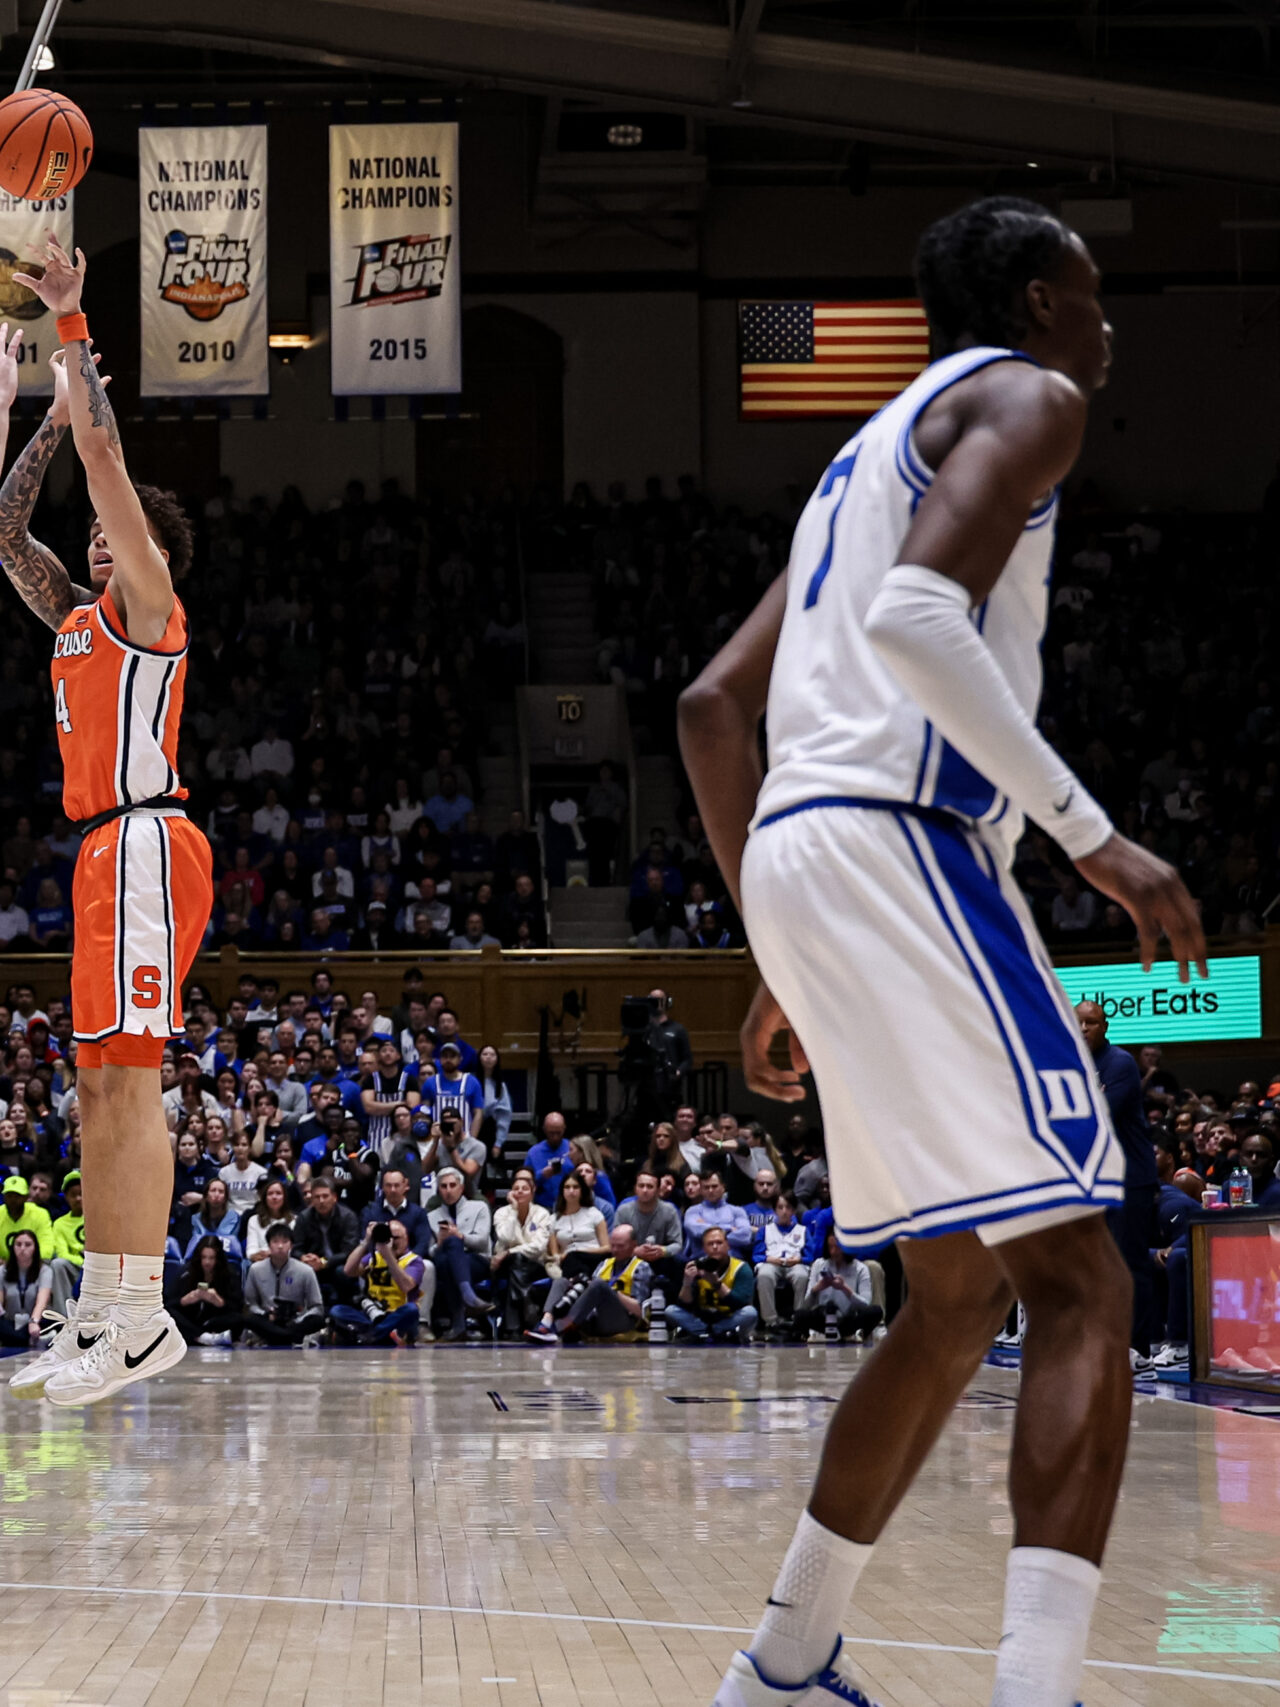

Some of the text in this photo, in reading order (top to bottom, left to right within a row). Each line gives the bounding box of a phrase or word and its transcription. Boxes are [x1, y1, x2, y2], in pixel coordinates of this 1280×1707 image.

[41, 152, 69, 198] ELITE
[158, 159, 249, 182] NATIONAL
[348, 156, 440, 180] NATIONAL
[148, 189, 261, 213] CHAMPIONS
[337, 185, 453, 210] CHAMPIONS
[187, 237, 247, 261] FINAL
[384, 240, 445, 267] FINAL
[163, 254, 248, 288] FOUR
[178, 340, 236, 363] 2010
[369, 338, 427, 361] 2015
[803, 442, 863, 611] 7
[560, 701, 581, 720] 10
[131, 965, 162, 1008] S
[1152, 988, 1219, 1016] Eats
[1037, 1069, 1091, 1120] D
